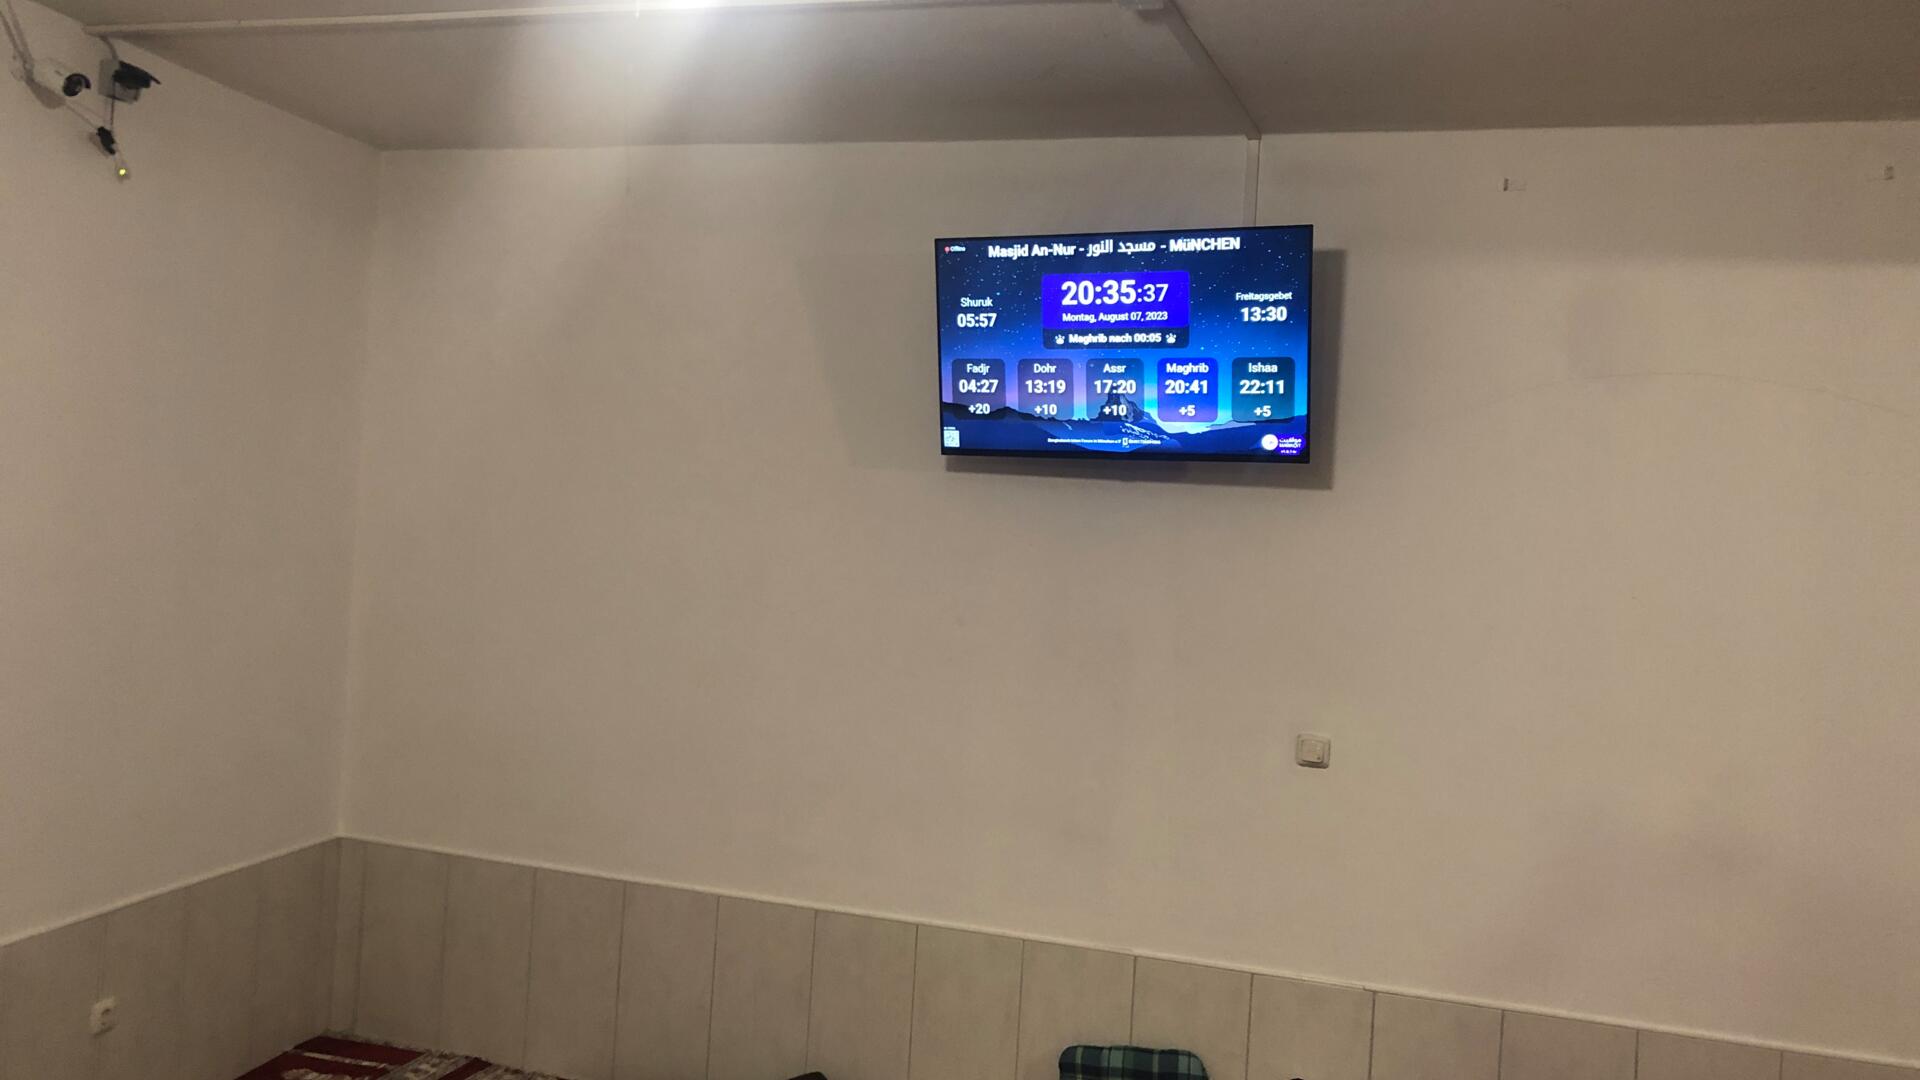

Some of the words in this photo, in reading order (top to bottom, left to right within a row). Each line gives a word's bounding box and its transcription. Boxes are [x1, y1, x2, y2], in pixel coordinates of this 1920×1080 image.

[988, 244, 1029, 260] Masjid
[1031, 244, 1076, 256] An-Nur
[1086, 239, 1113, 257] النور
[1117, 242, 1156, 255] مسجد
[1061, 279, 1168, 305] 20:35:37
[1236, 291, 1292, 302] Freitagsgebet
[961, 297, 993, 307] Shuruk
[1062, 313, 1097, 323] Montag,
[1098, 312, 1129, 323] August
[1130, 311, 1144, 322] 07,
[1145, 311, 1168, 321] 2023
[1241, 306, 1287, 322] 13:30
[957, 313, 997, 328] 05:57
[1069, 333, 1108, 345] Maghrib
[1108, 333, 1132, 343] nach
[1133, 333, 1162, 342] 00:05
[967, 363, 990, 375] Fadjr
[1034, 363, 1057, 373] Dohr
[1103, 363, 1126, 373] Assr
[1166, 363, 1209, 375] Maghrib
[1248, 362, 1278, 373] Ishaa
[959, 379, 998, 393] 04:27
[1025, 379, 1066, 393] 13:19
[1094, 379, 1136, 394] 17:20
[1165, 379, 1208, 394] 20:41
[1240, 379, 1284, 394] 22:11
[968, 403, 990, 414] +20
[1034, 404, 1057, 415] +10
[1103, 404, 1127, 416] +10
[1178, 405, 1196, 417] +5
[1254, 405, 1271, 417] +5
